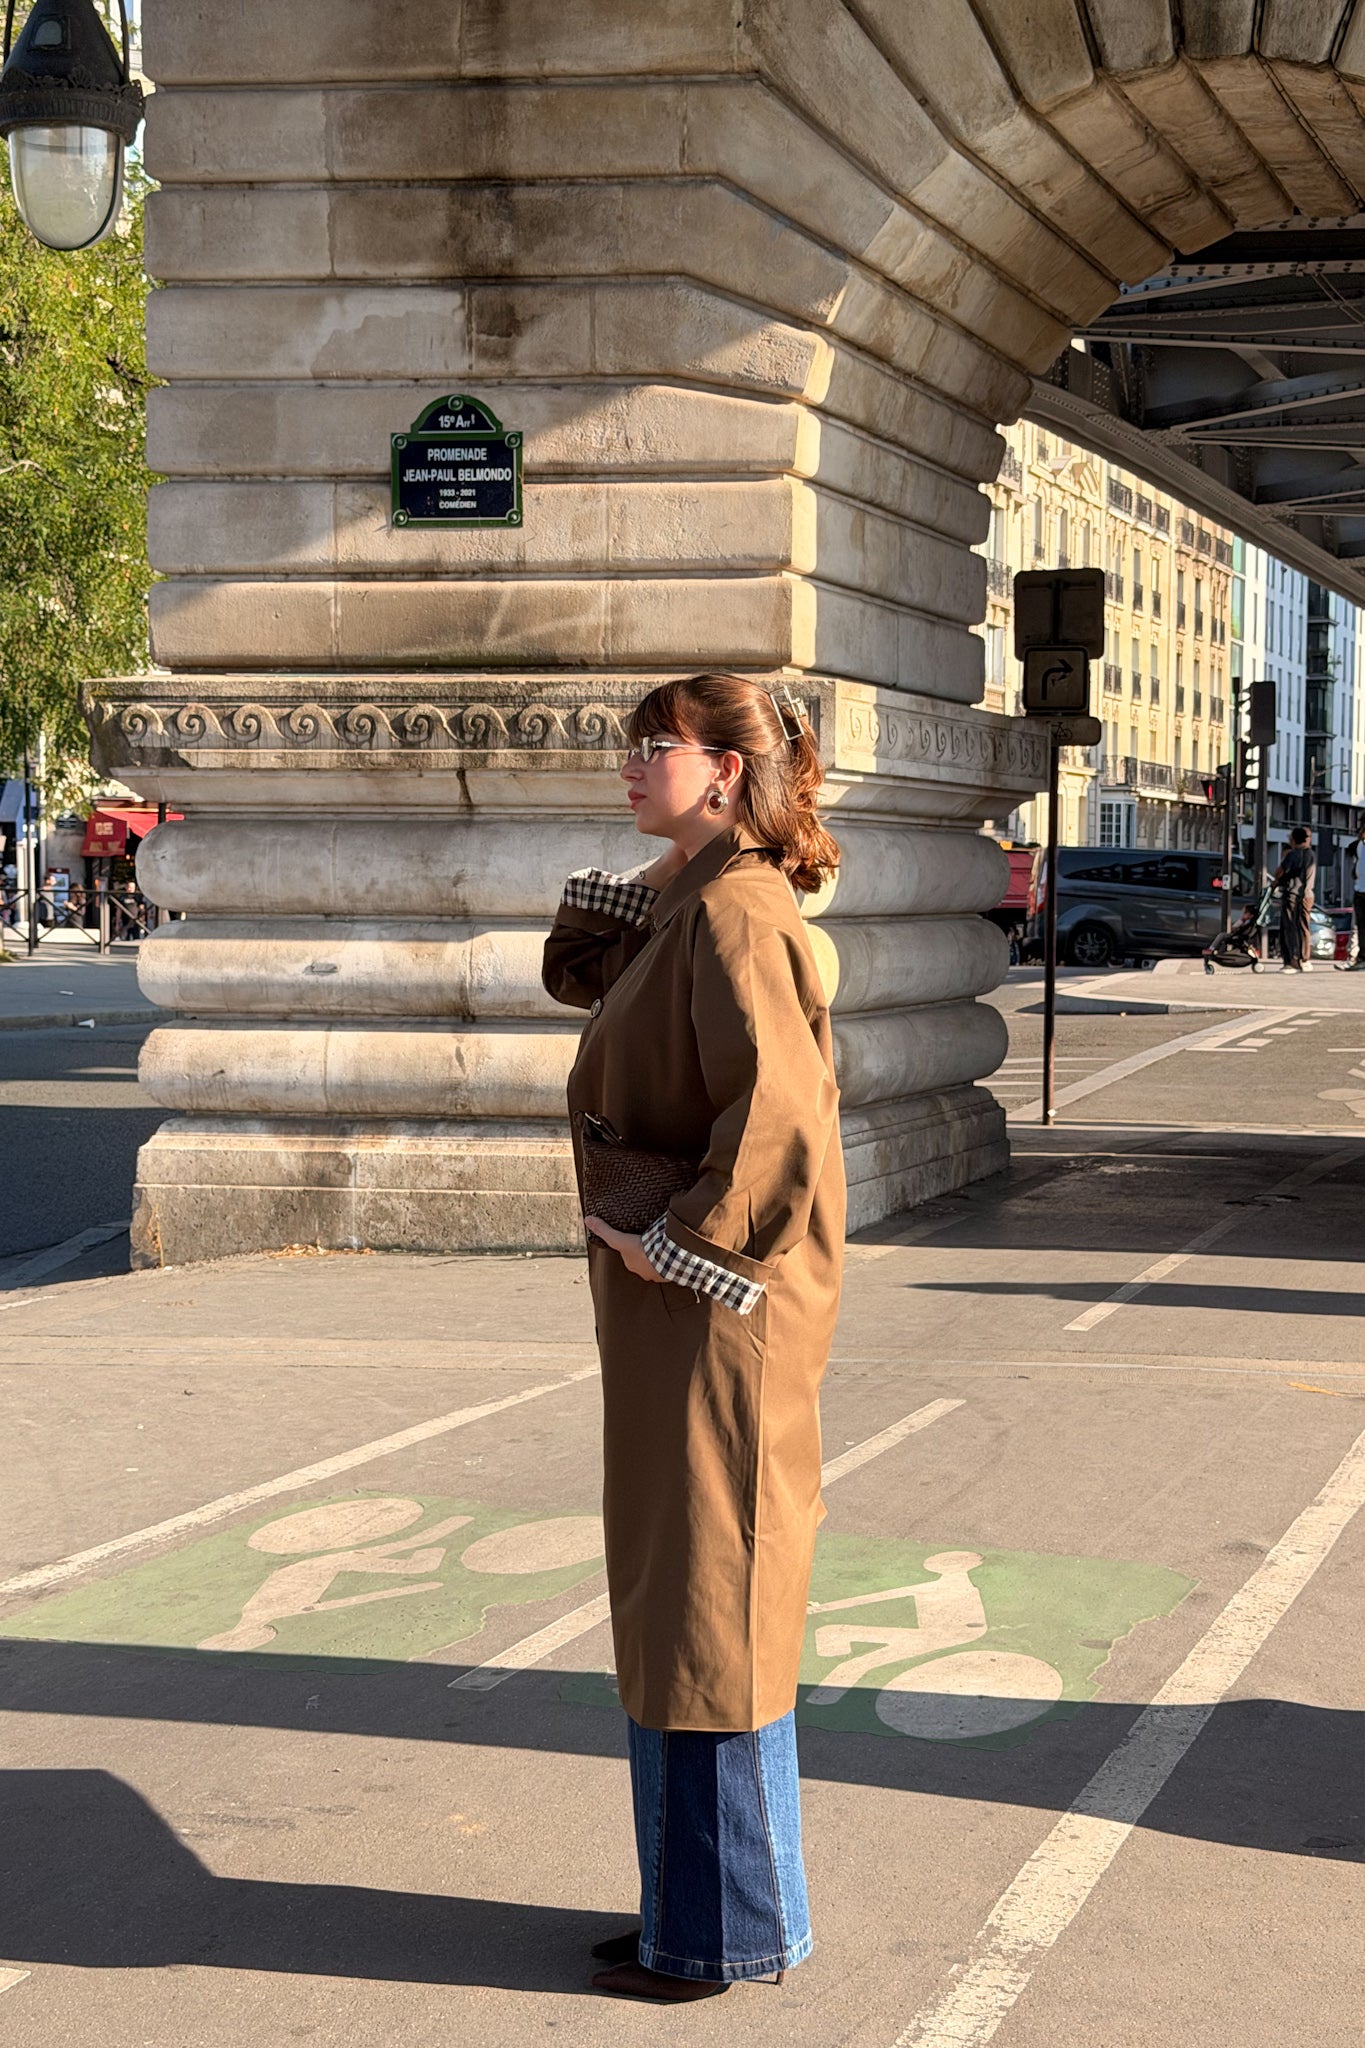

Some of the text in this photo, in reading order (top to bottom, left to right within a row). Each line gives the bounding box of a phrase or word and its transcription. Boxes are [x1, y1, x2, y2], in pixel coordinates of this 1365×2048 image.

[427, 448, 487, 461] PROMENADE
[403, 468, 512, 482] JEAN-PAUL BELMONDO
[439, 498, 477, 509] COMÉDIEN
